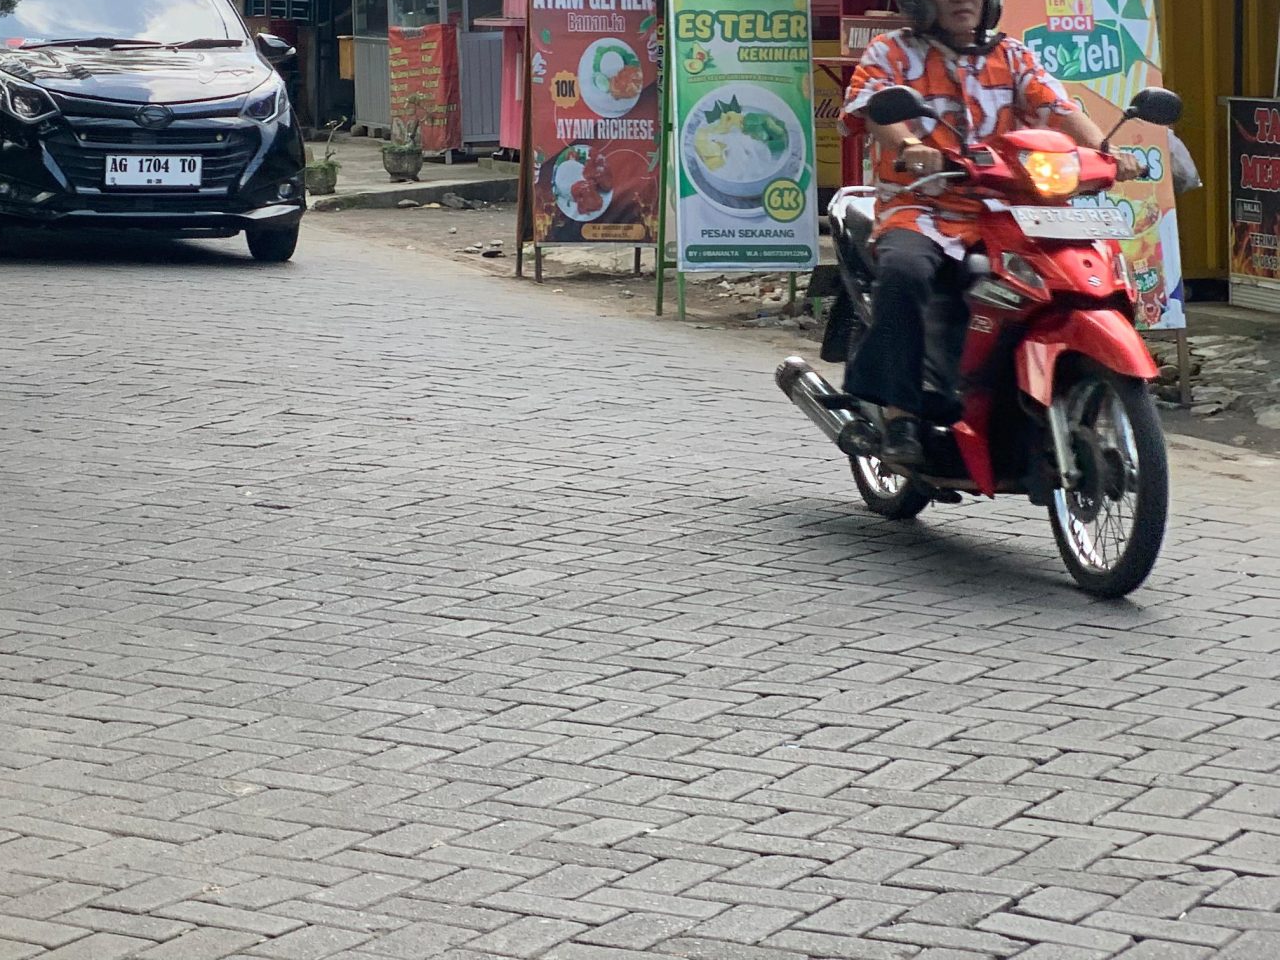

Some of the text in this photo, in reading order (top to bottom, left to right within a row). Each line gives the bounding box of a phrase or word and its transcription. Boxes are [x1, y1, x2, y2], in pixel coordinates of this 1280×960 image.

[677, 12, 807, 40] ES TELER
[1049, 16, 1091, 30] POCI
[738, 47, 808, 61] KEKINIAN
[1072, 34, 1120, 73] Teh
[555, 80, 575, 97] 10K
[557, 118, 654, 140] AYAM RICHEESE
[110, 158, 196, 173] AG 1704 TO
[769, 188, 799, 209] 6K
[701, 229, 795, 238] PESAN SEKARANG
